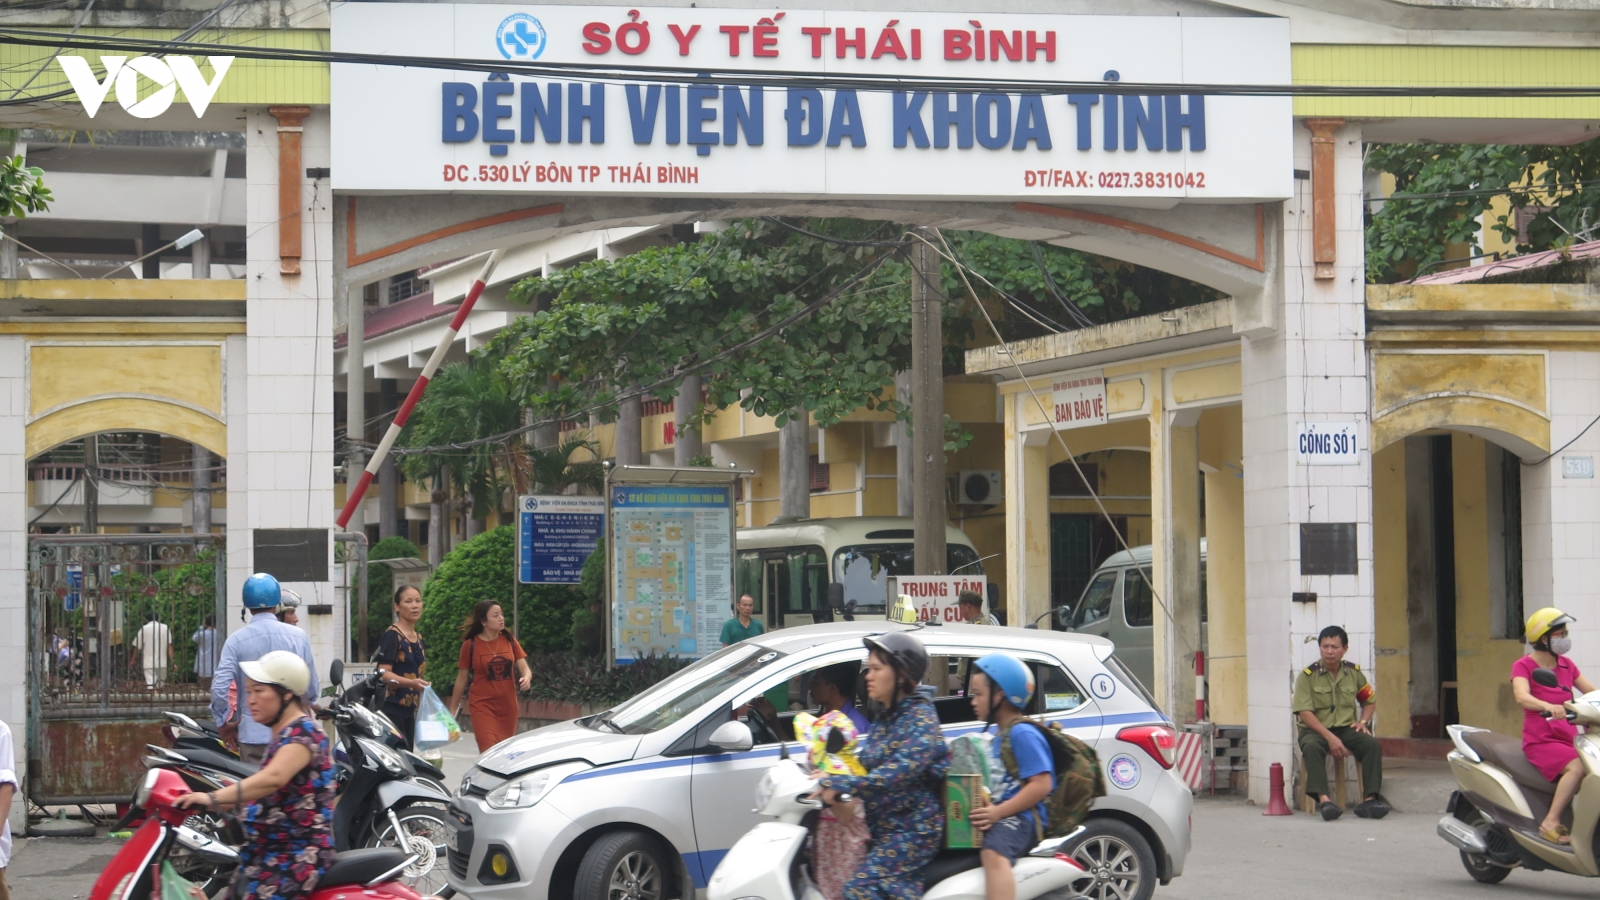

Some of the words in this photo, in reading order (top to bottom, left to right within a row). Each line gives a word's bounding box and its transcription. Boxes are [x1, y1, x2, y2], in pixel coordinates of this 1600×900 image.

[582, 9, 651, 55] SỞ
[668, 24, 701, 56] Y
[720, 12, 786, 58] TẾ
[802, 19, 922, 60] THÁI
[944, 20, 1057, 62] BÌNH
[441, 72, 606, 157] BỆNH
[624, 72, 764, 157] VIỆN
[785, 84, 867, 149] ĐA
[893, 88, 1053, 151] KHOA
[1067, 70, 1207, 152] TỈNH
[512, 161, 531, 183] LÝ
[536, 162, 573, 184] BÔN
[578, 165, 601, 184] TP
[608, 162, 652, 184] THÁI
[657, 162, 699, 185] BÌNH
[1024, 170, 1094, 188] ĐT/FAX:
[1098, 171, 1206, 190] 0227.3831042
[1055, 402, 1073, 423] BAN
[1074, 392, 1091, 421] BẢO
[1092, 393, 1104, 422] VỆ
[1299, 424, 1331, 455] CỔNG
[1333, 426, 1348, 455] SỐ
[1351, 434, 1356, 454] 1
[1566, 459, 1590, 475] 530
[902, 582, 948, 597] TRUNG
[953, 578, 983, 597] TÂM
[1100, 680, 1107, 693] 6
